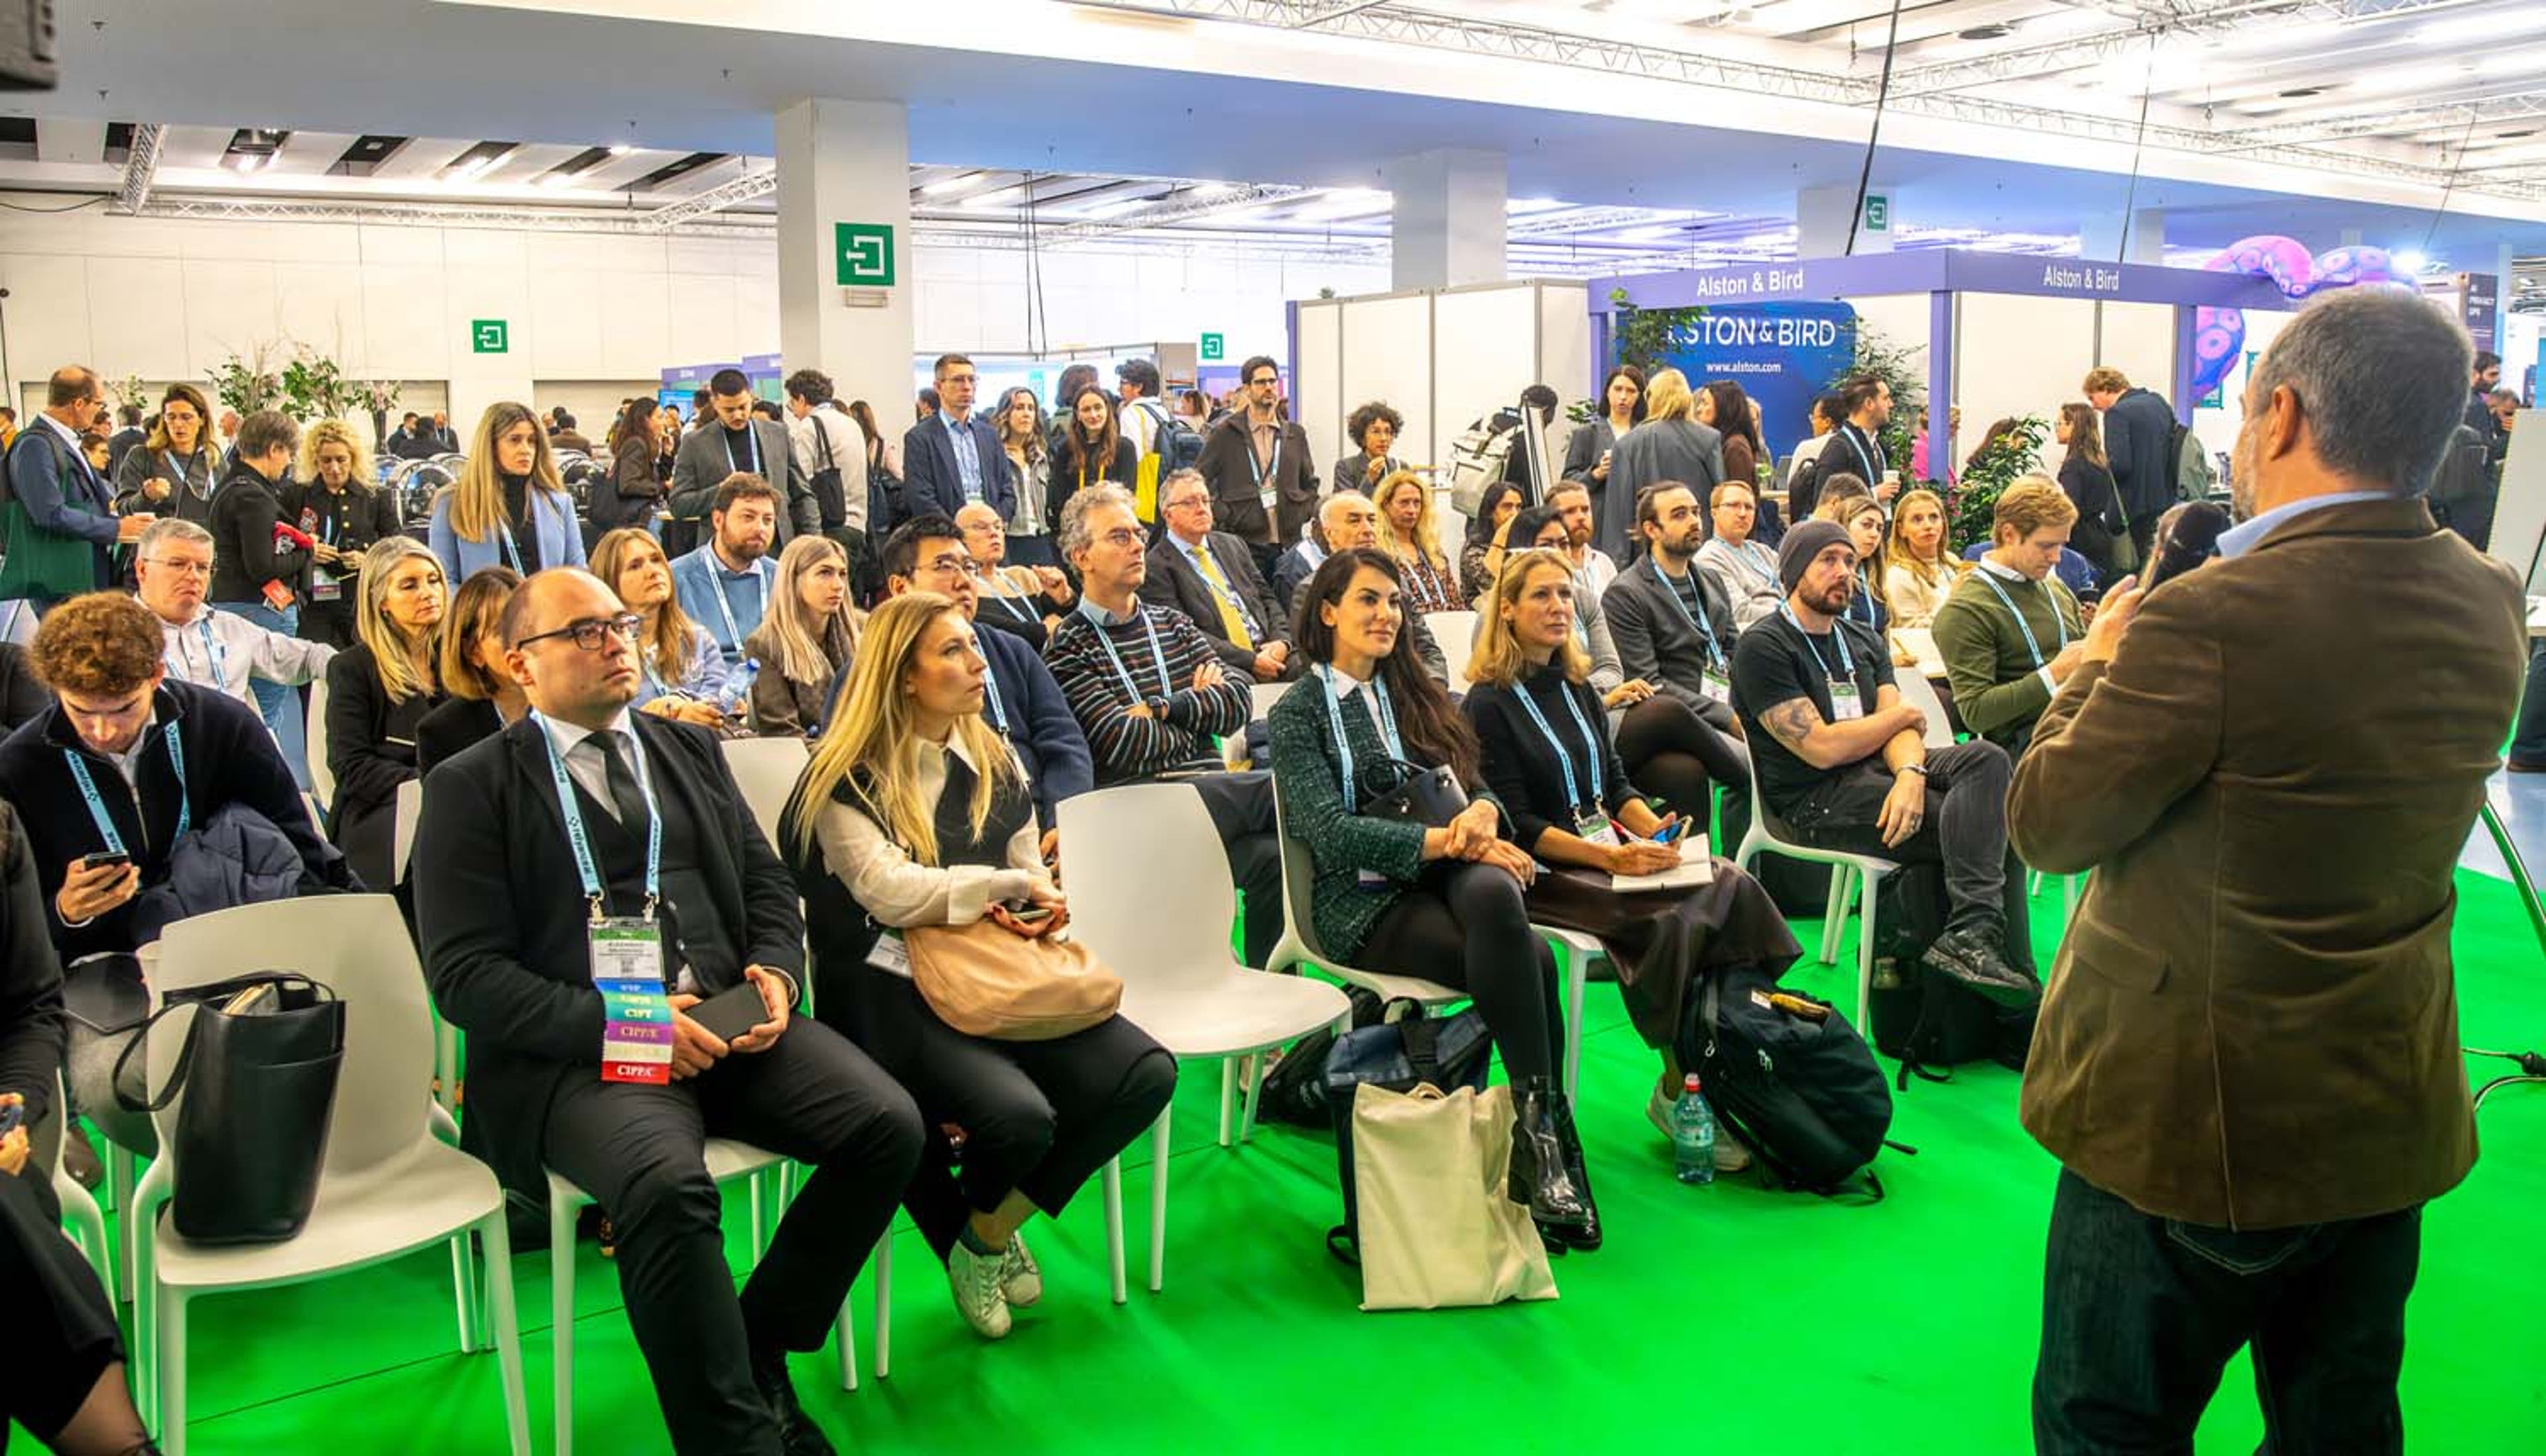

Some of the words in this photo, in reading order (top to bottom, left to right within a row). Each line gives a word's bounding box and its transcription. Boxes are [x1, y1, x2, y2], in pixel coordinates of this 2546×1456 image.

[1697, 276, 1747, 296] Alston
[1752, 272, 1764, 292] &
[1769, 269, 1803, 290] Bird
[2043, 265, 2081, 288] Alston
[2084, 268, 2093, 289] &
[2096, 269, 2119, 290] Bird
[1760, 321, 1773, 343] &
[1778, 318, 1835, 346] BIRD
[1707, 360, 1782, 373] www.alston.com
